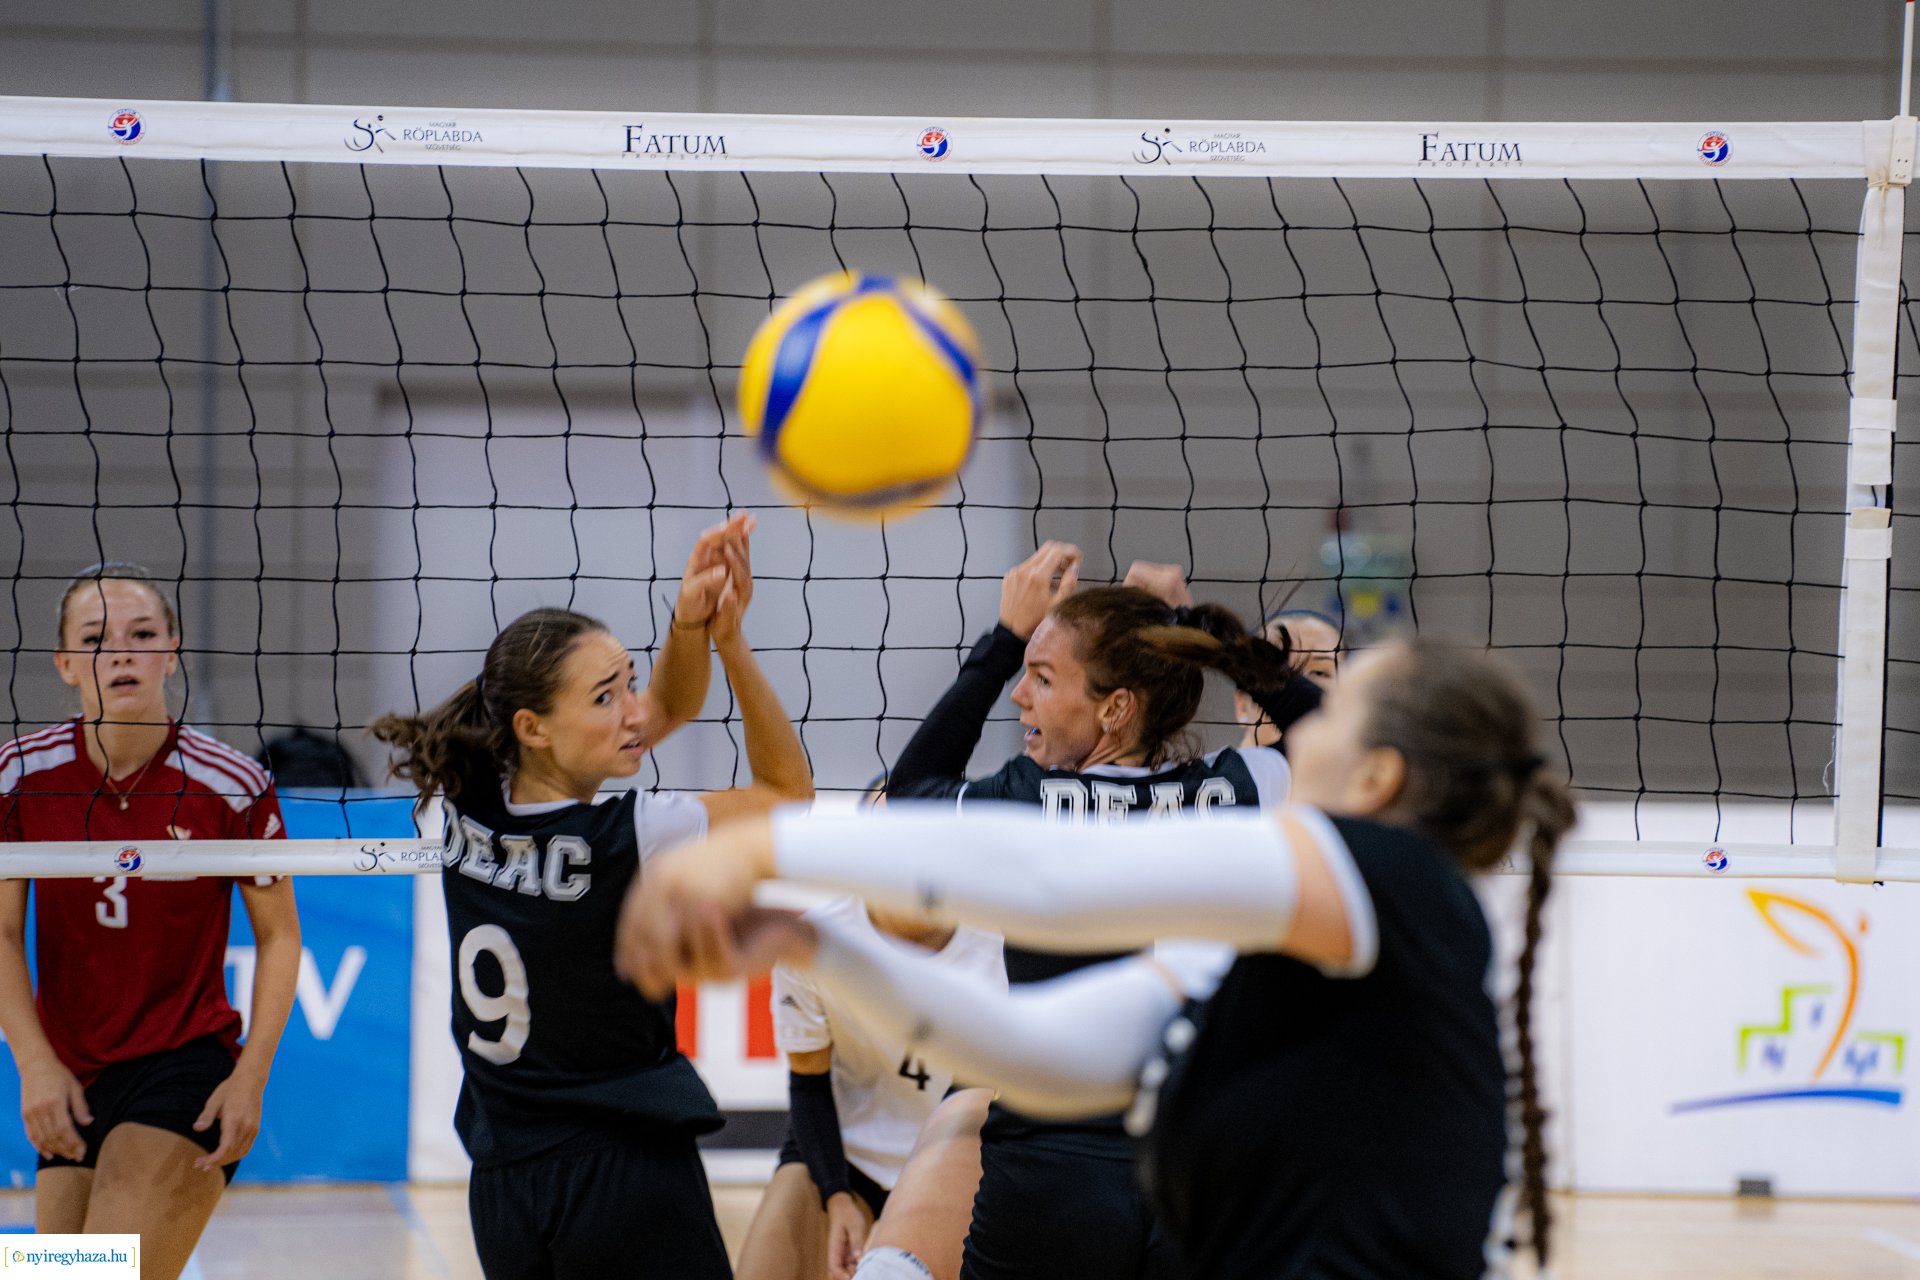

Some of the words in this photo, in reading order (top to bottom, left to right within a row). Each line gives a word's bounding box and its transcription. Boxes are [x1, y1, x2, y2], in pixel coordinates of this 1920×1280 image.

[93, 876, 128, 929] 3
[458, 924, 531, 1066] 9
[898, 1053, 931, 1091] 4
